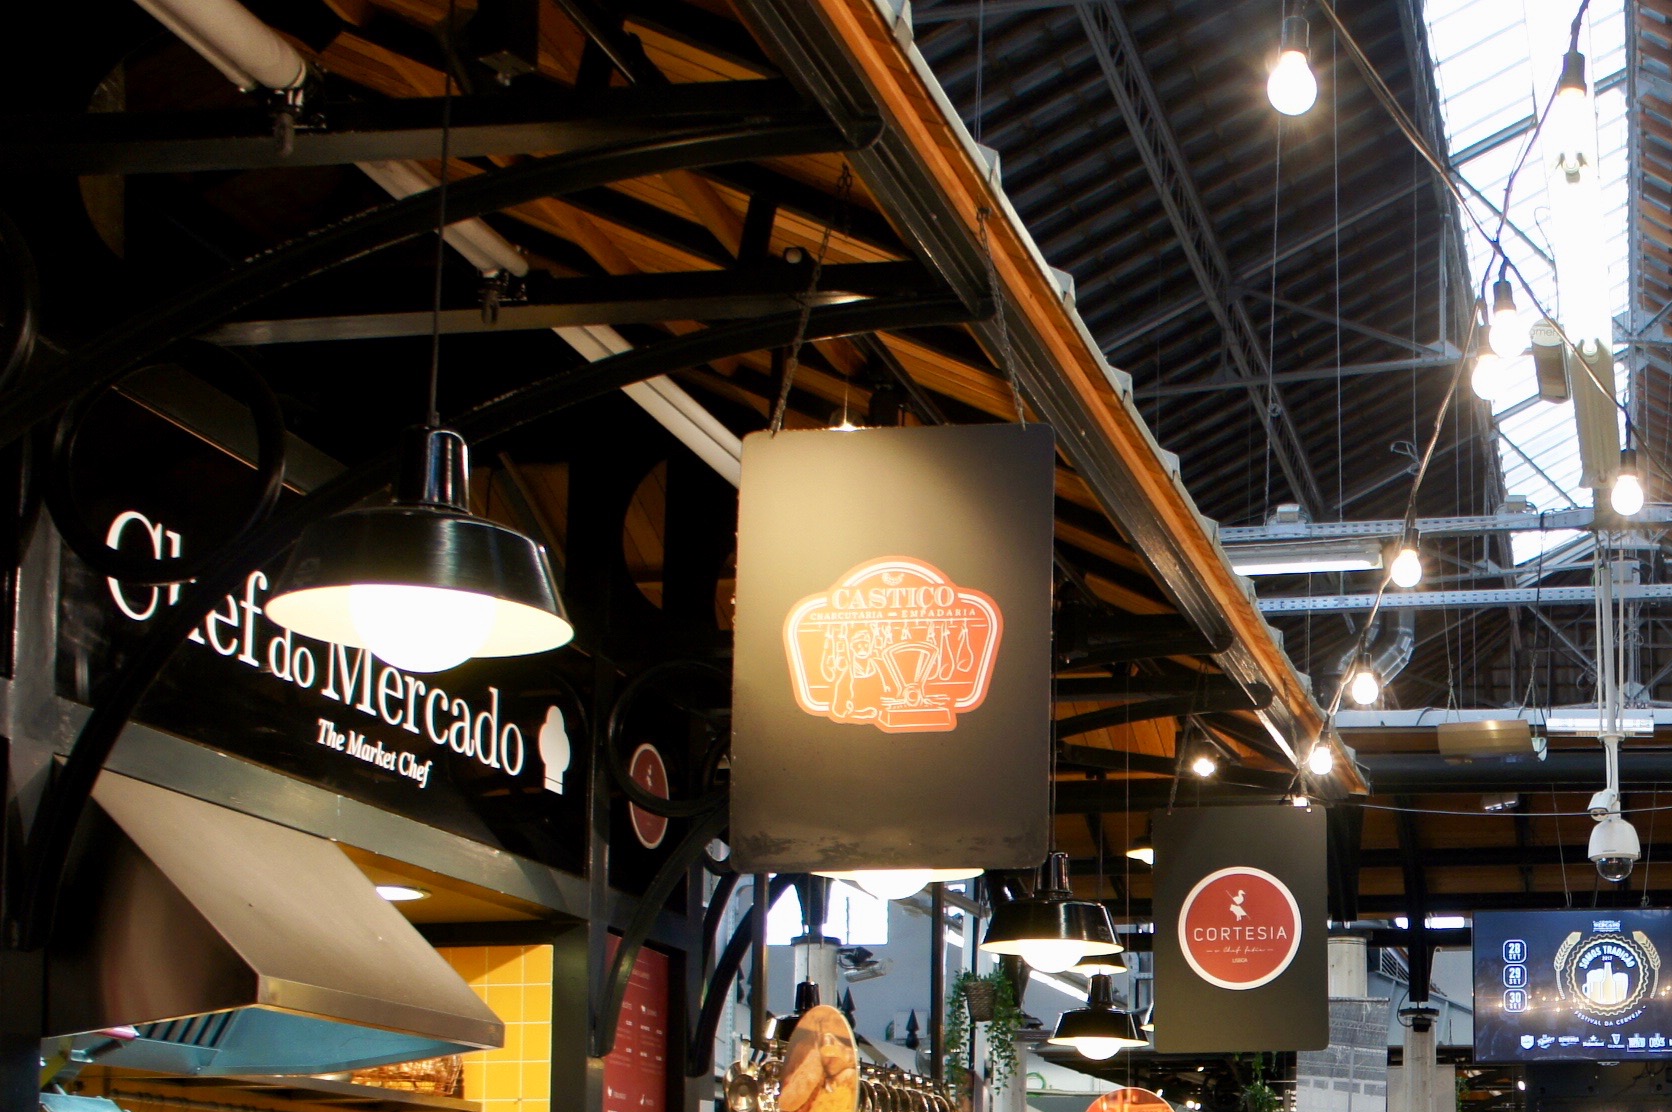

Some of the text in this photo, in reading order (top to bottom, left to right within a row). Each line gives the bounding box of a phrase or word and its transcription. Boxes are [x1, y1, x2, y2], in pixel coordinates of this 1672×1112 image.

[832, 586, 955, 612] CASTIÇO
[810, 608, 976, 621] CHARCUTARIA EMPADARIA
[268, 628, 315, 688] do
[321, 641, 525, 777] Mercado
[317, 718, 433, 789] The Market Chef
[1193, 926, 1288, 942] CORTESIA
[1508, 943, 1521, 955] 28
[1578, 945, 1637, 969] SOMOS TRADIÇÃO
[1508, 967, 1521, 979] 29
[1509, 992, 1521, 1004] 30
[1573, 1009, 1601, 1026] FESTIVAL
[1616, 1008, 1643, 1026] CERVEJA
